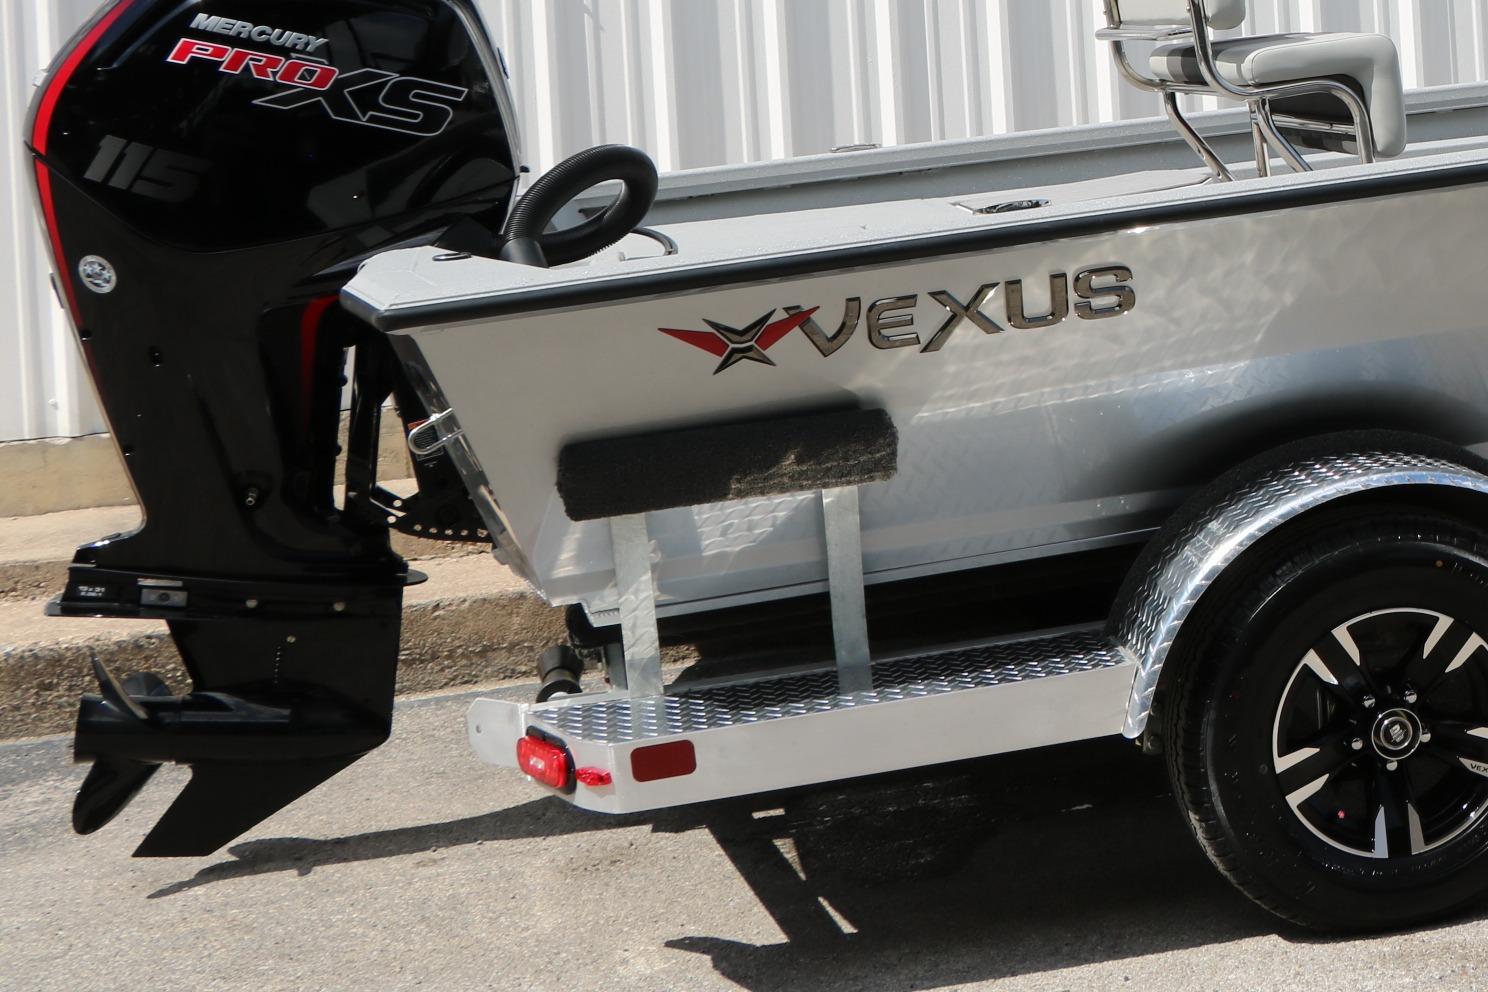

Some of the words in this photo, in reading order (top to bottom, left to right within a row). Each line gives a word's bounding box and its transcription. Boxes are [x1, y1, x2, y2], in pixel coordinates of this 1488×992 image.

[189, 12, 329, 52] MERCURY
[83, 133, 212, 202] 115
[782, 264, 1136, 357] VEXUS
